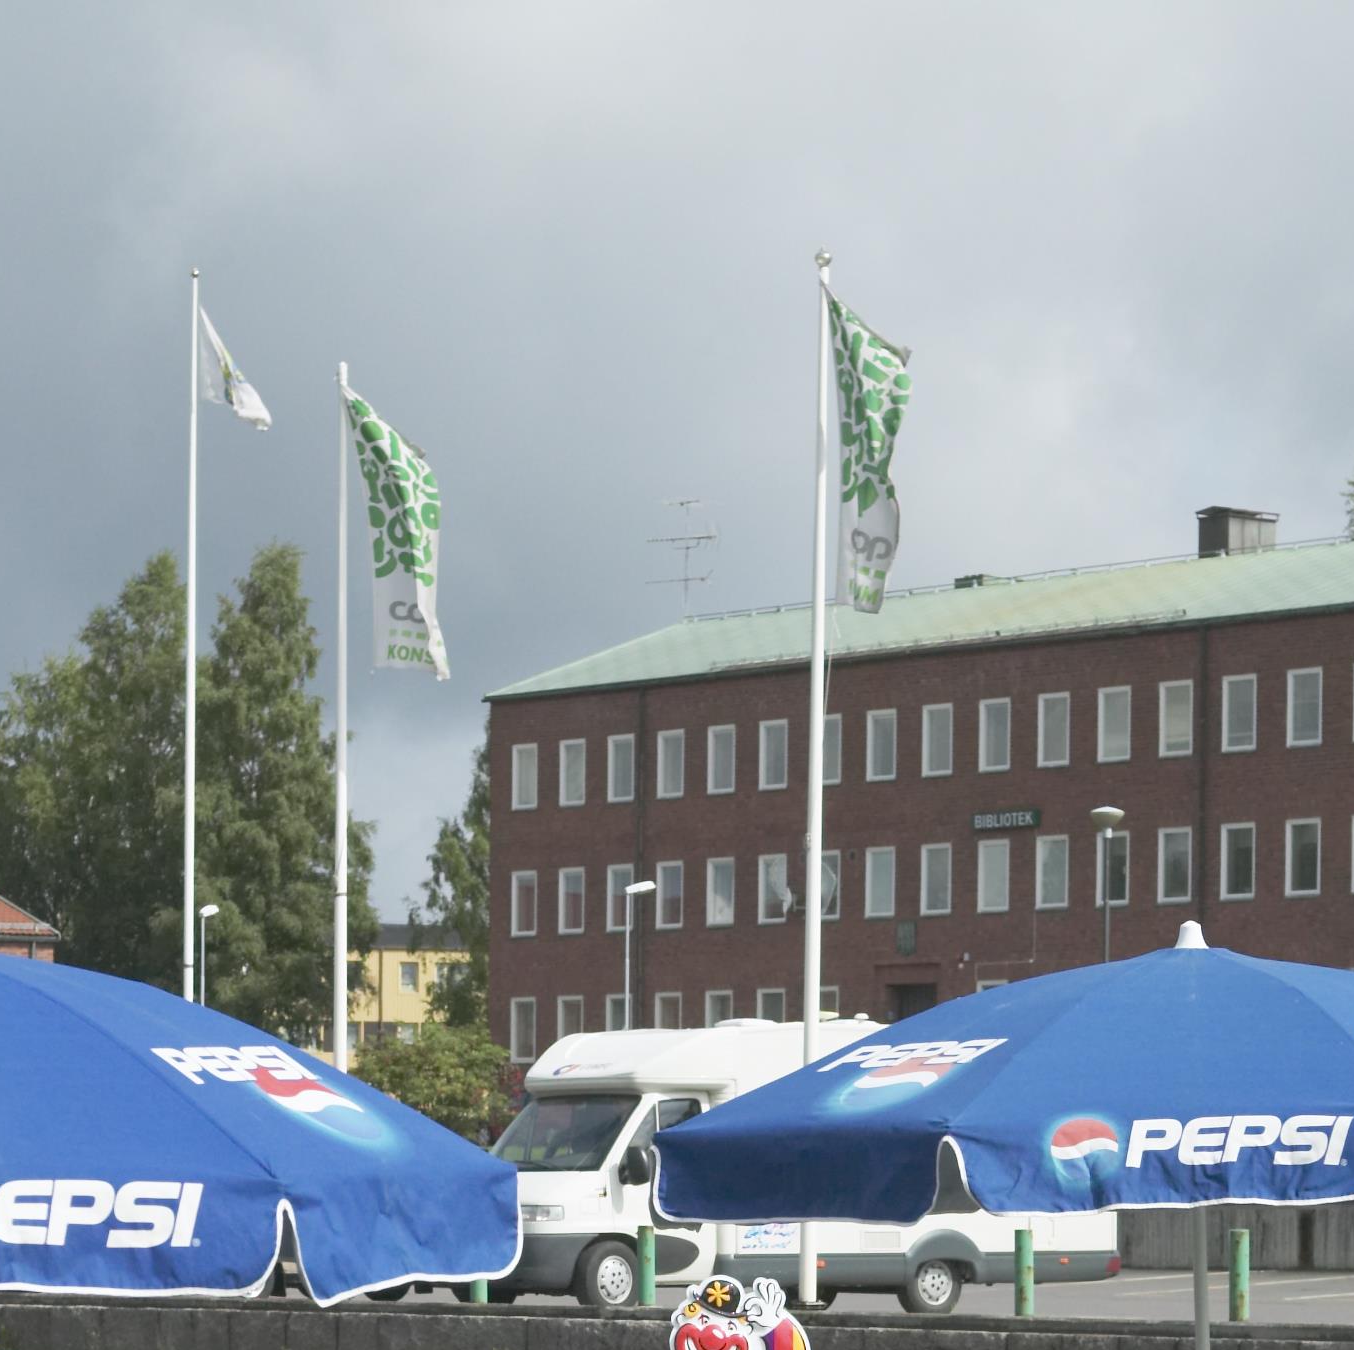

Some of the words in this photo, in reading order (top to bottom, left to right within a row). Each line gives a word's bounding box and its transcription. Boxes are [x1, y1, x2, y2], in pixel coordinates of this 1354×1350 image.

[974, 811, 1034, 829] BIBLIOTEK
[150, 1045, 320, 1085] PEPSI
[816, 1038, 1009, 1073] PEPSI
[1125, 1114, 1354, 1168] PEPSI
